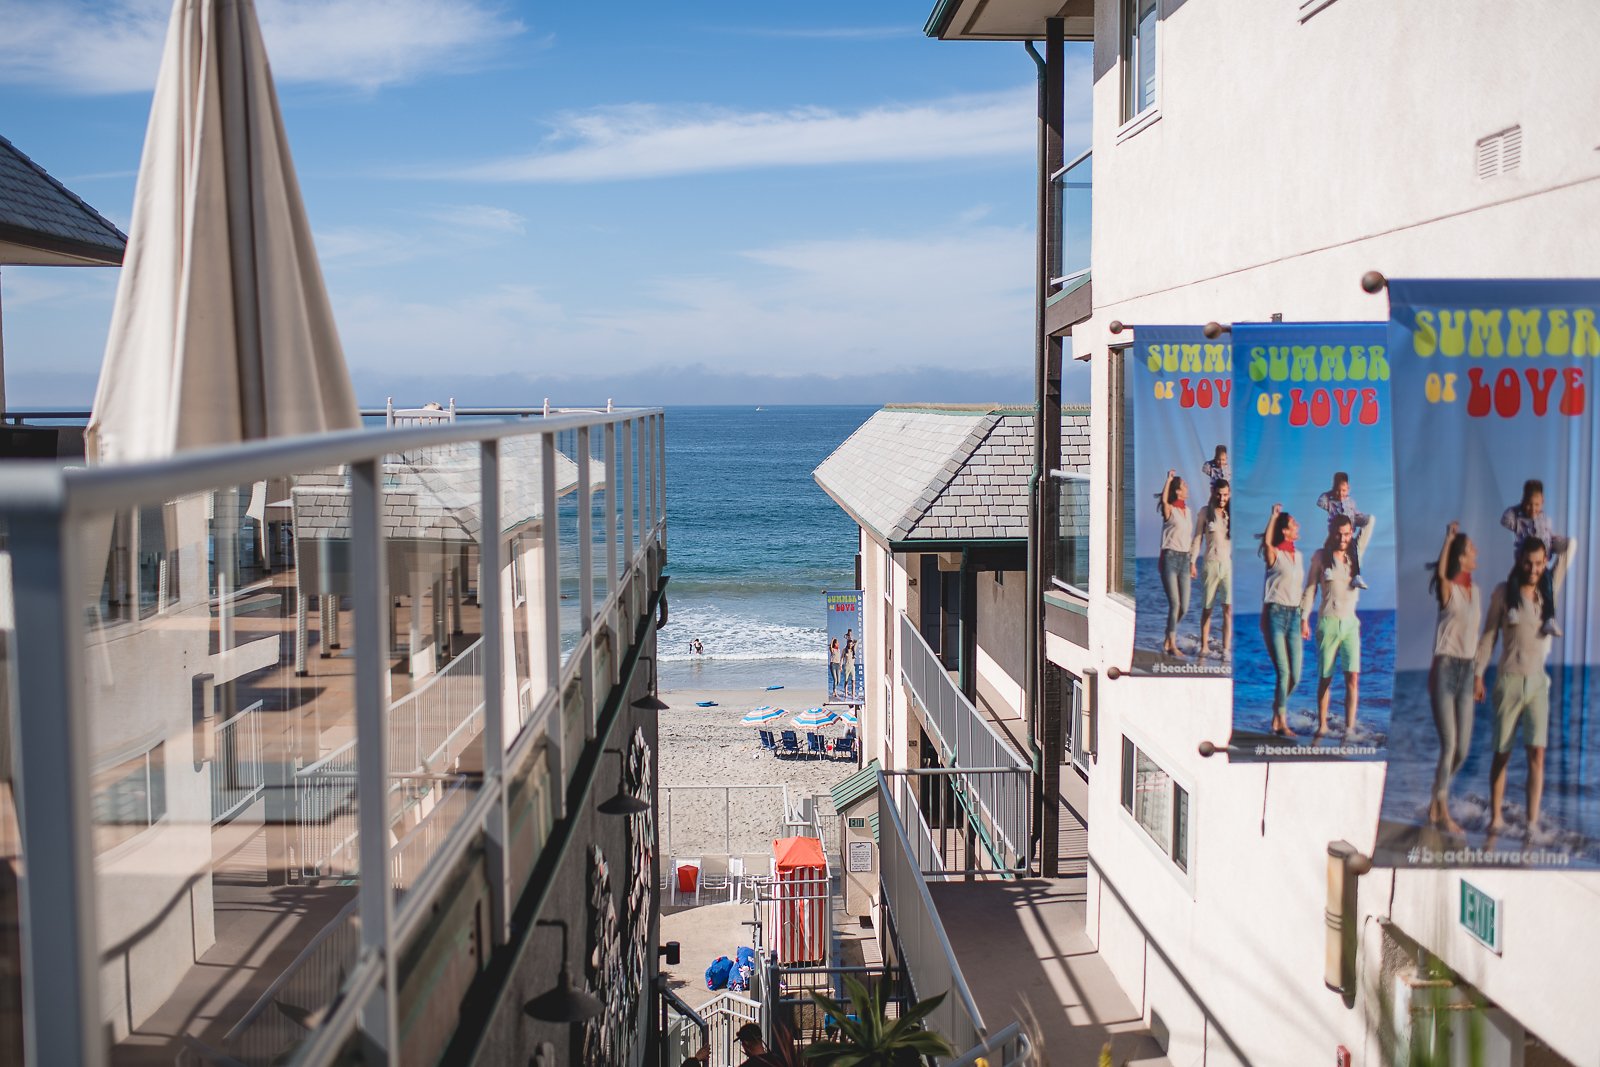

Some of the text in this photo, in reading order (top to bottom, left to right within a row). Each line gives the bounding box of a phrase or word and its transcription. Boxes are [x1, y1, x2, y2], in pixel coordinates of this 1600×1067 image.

[1413, 308, 1600, 358] SUMMER
[1148, 344, 1231, 373] SUMM
[1250, 346, 1390, 382] SUMMER
[1154, 381, 1174, 399] OF
[1425, 367, 1586, 418] OF LOVE
[1257, 388, 1380, 427] OF LOVE
[836, 603, 855, 611] LOVE
[1255, 744, 1376, 756] #beachterraceinn
[1407, 846, 1570, 866] #beachterraceinn
[1464, 884, 1493, 944] EXIT
